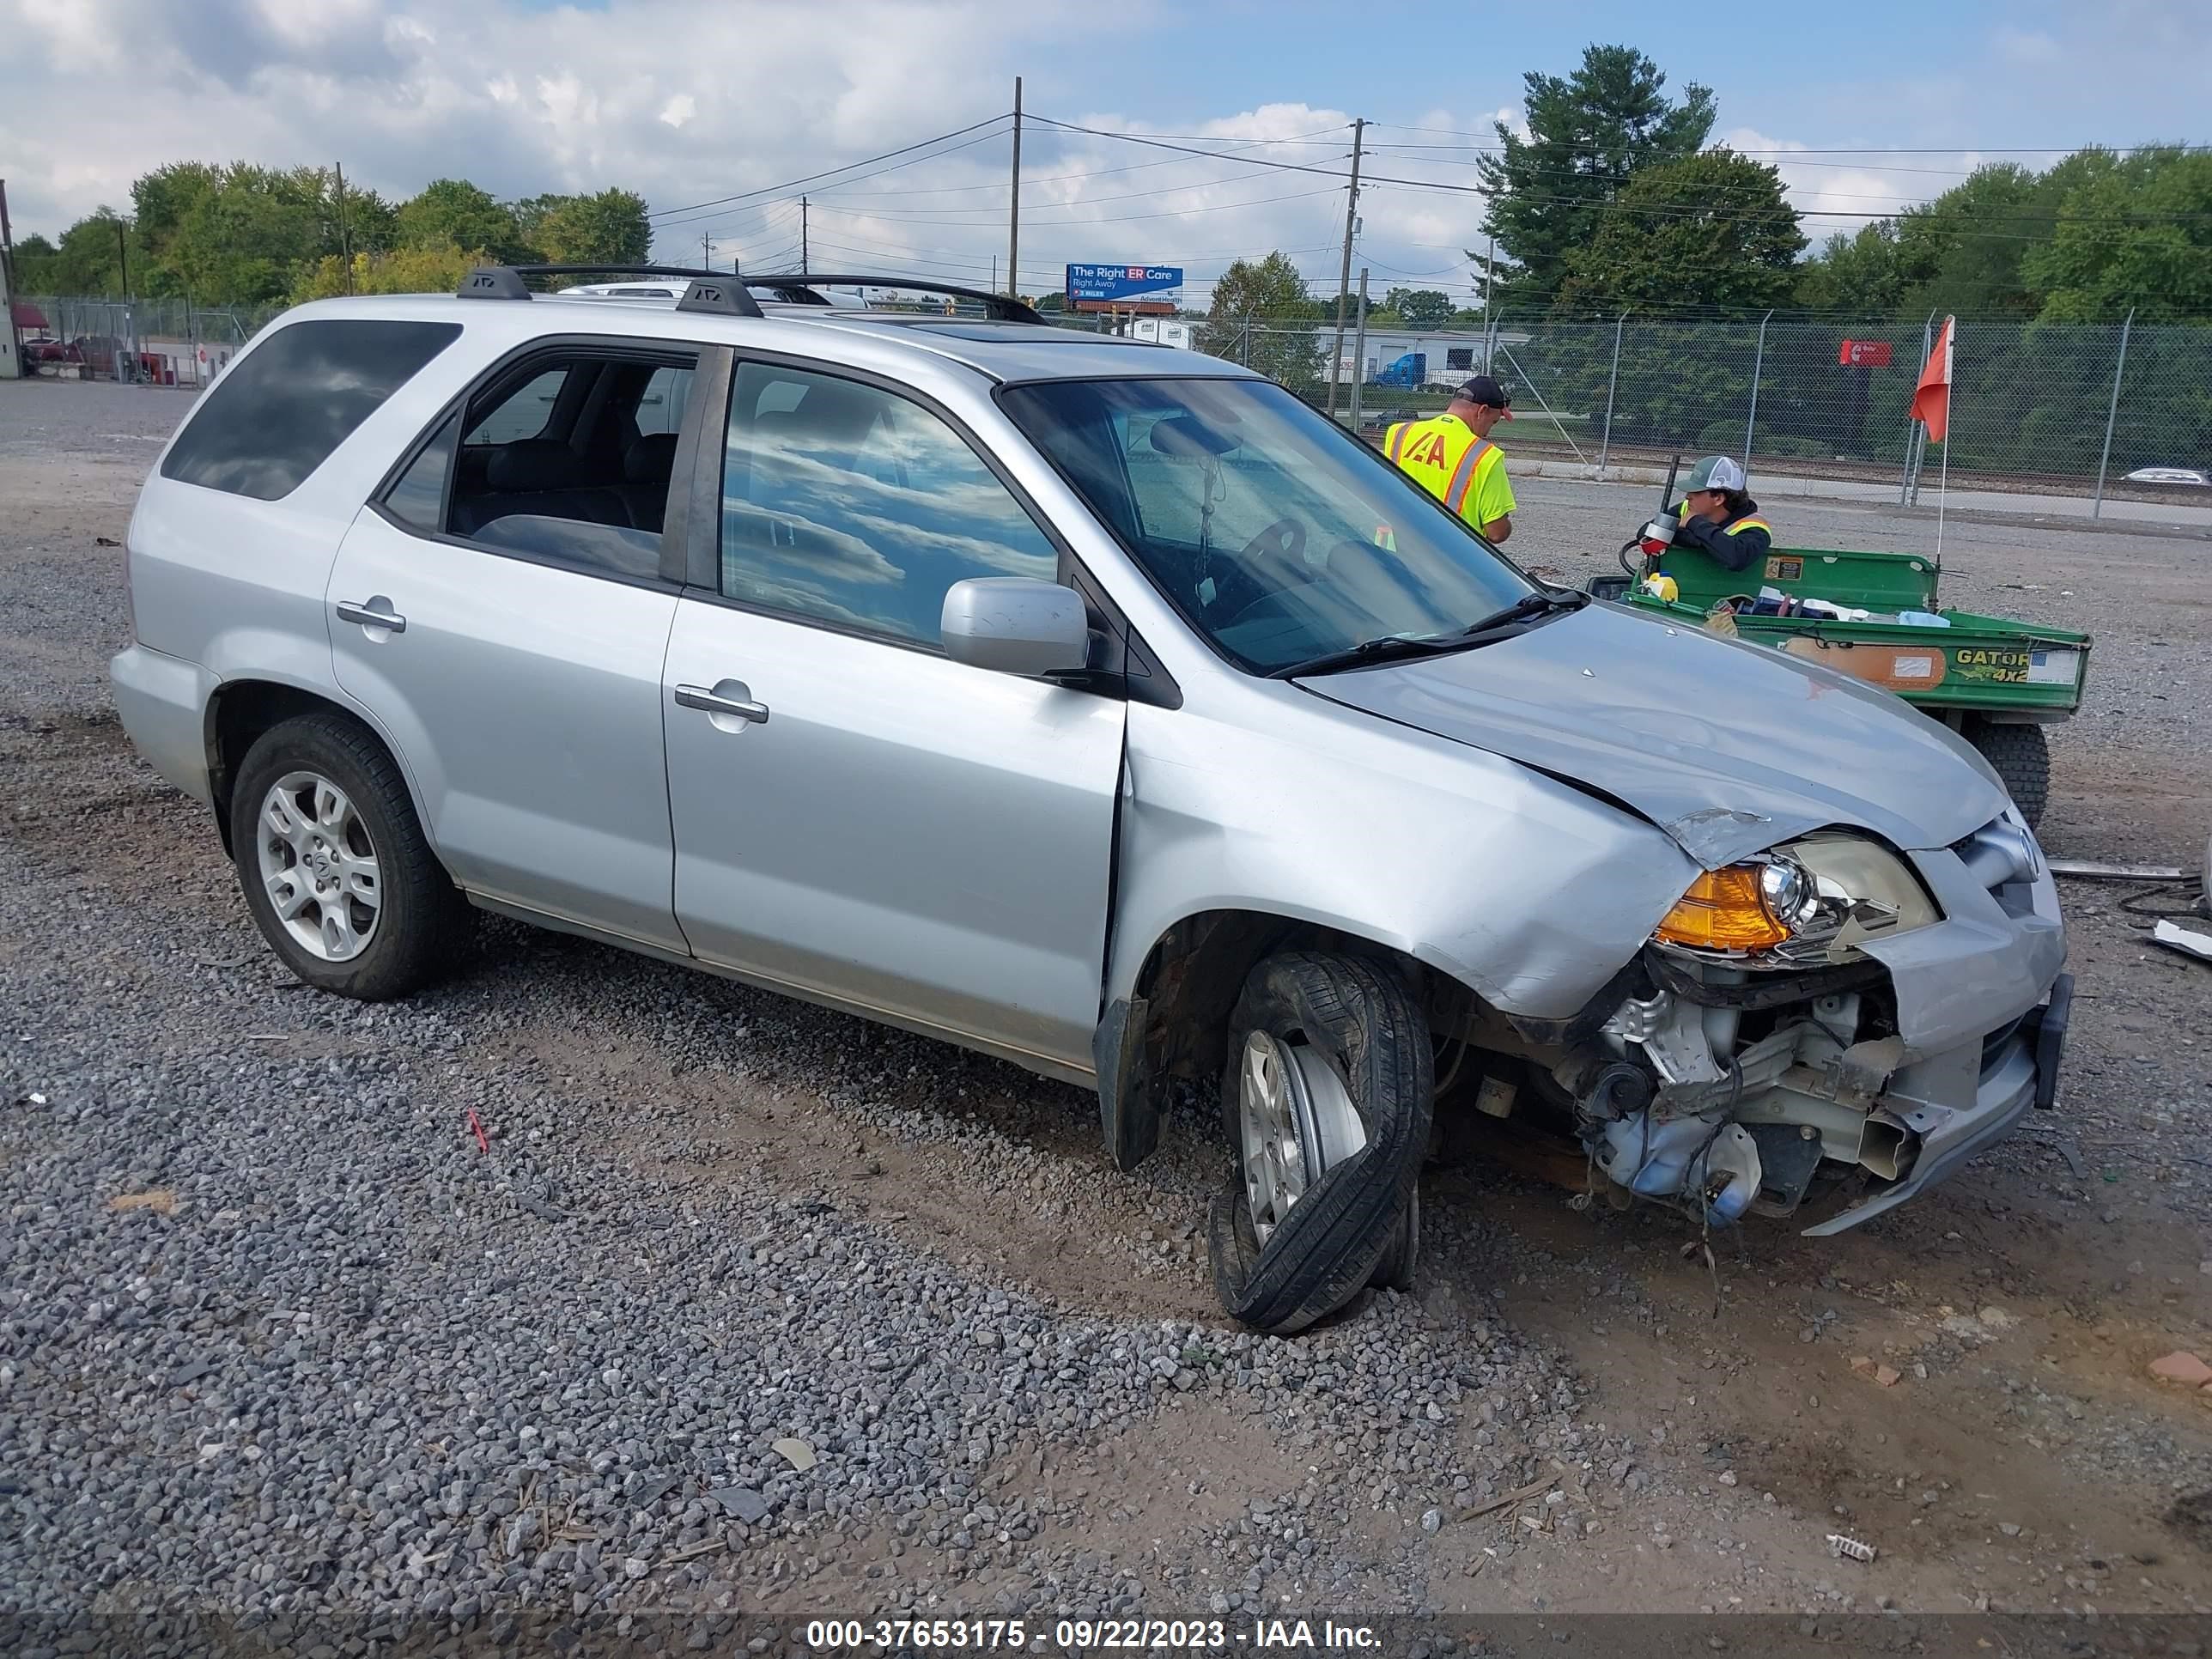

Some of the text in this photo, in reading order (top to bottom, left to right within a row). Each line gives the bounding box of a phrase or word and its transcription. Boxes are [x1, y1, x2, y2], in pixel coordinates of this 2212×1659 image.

[1073, 266, 1172, 281] The Right ER Care
[1073, 278, 1116, 289] Right Away
[1957, 649, 2030, 666] GATOR
[1992, 668, 2028, 683] 4x2
